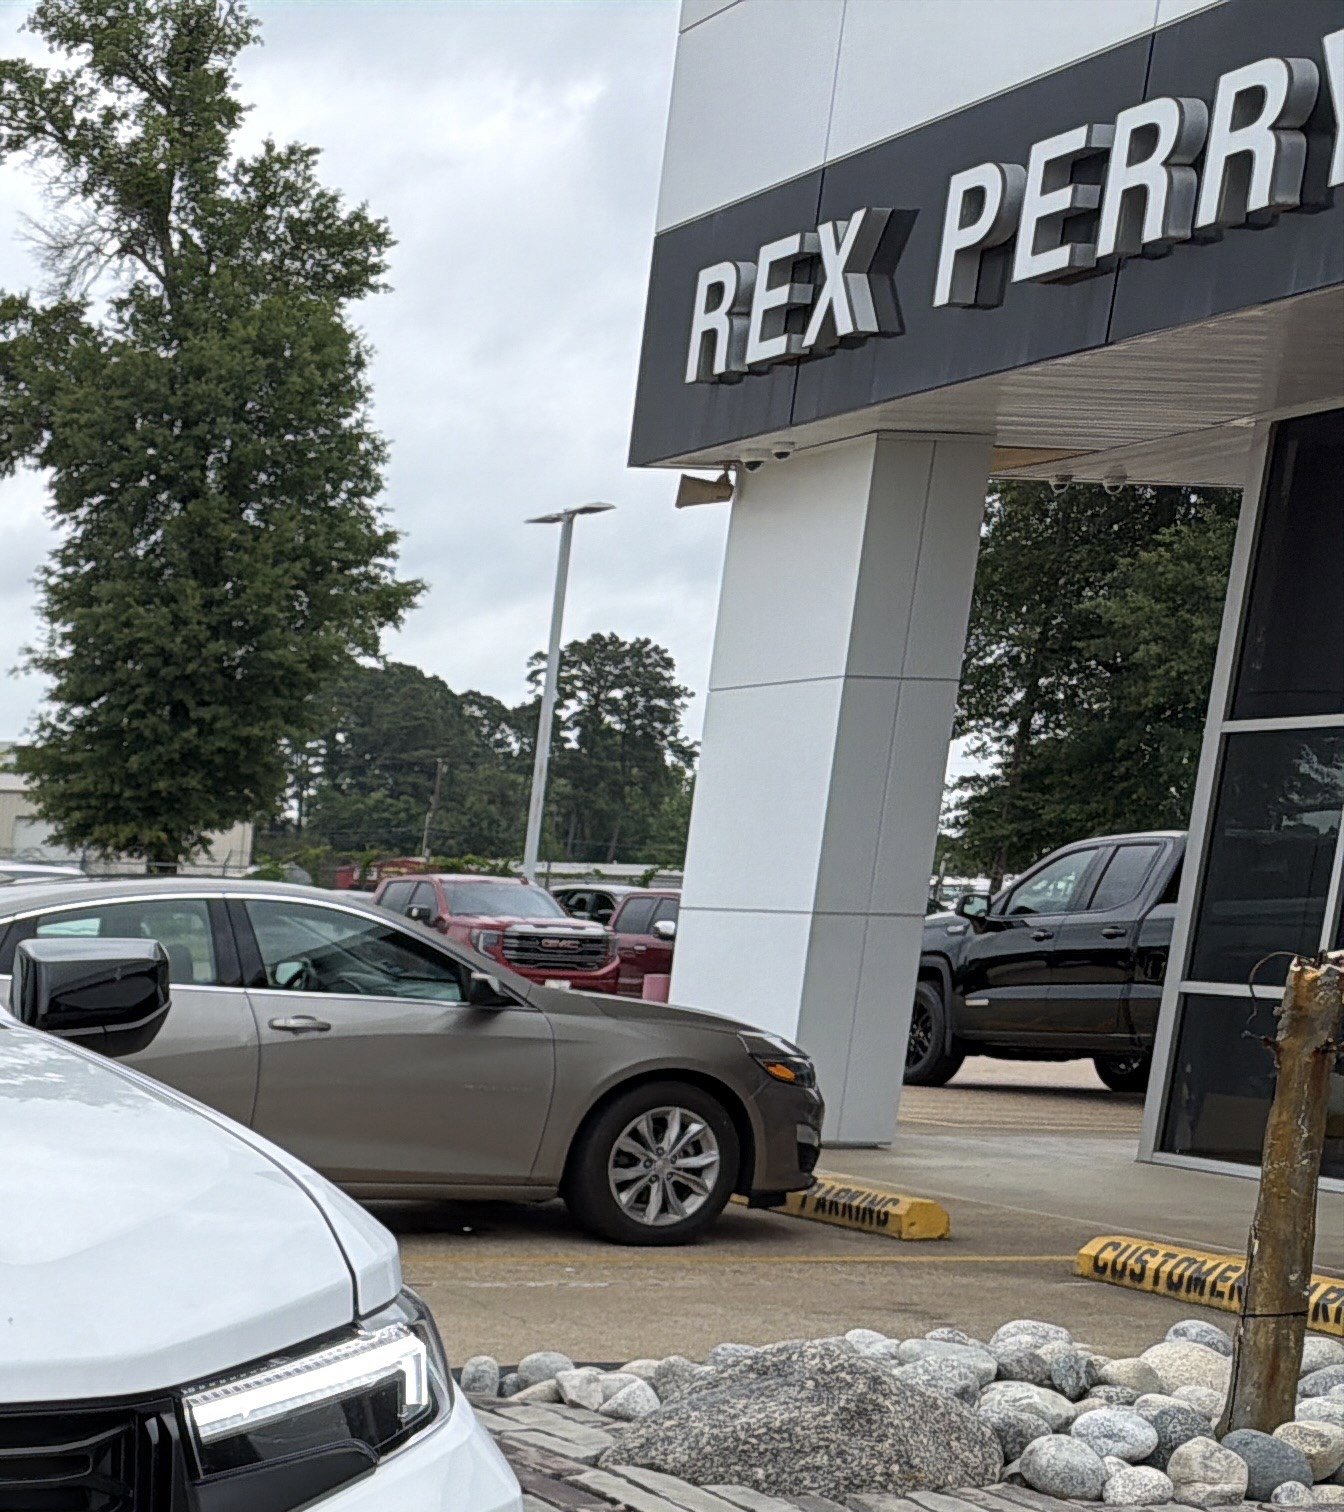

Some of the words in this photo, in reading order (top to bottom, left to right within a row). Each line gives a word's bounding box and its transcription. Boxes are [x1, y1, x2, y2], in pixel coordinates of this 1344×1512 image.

[685, 207, 868, 384] REX
[541, 938, 580, 948] GMC
[800, 1182, 900, 1227] PARKING
